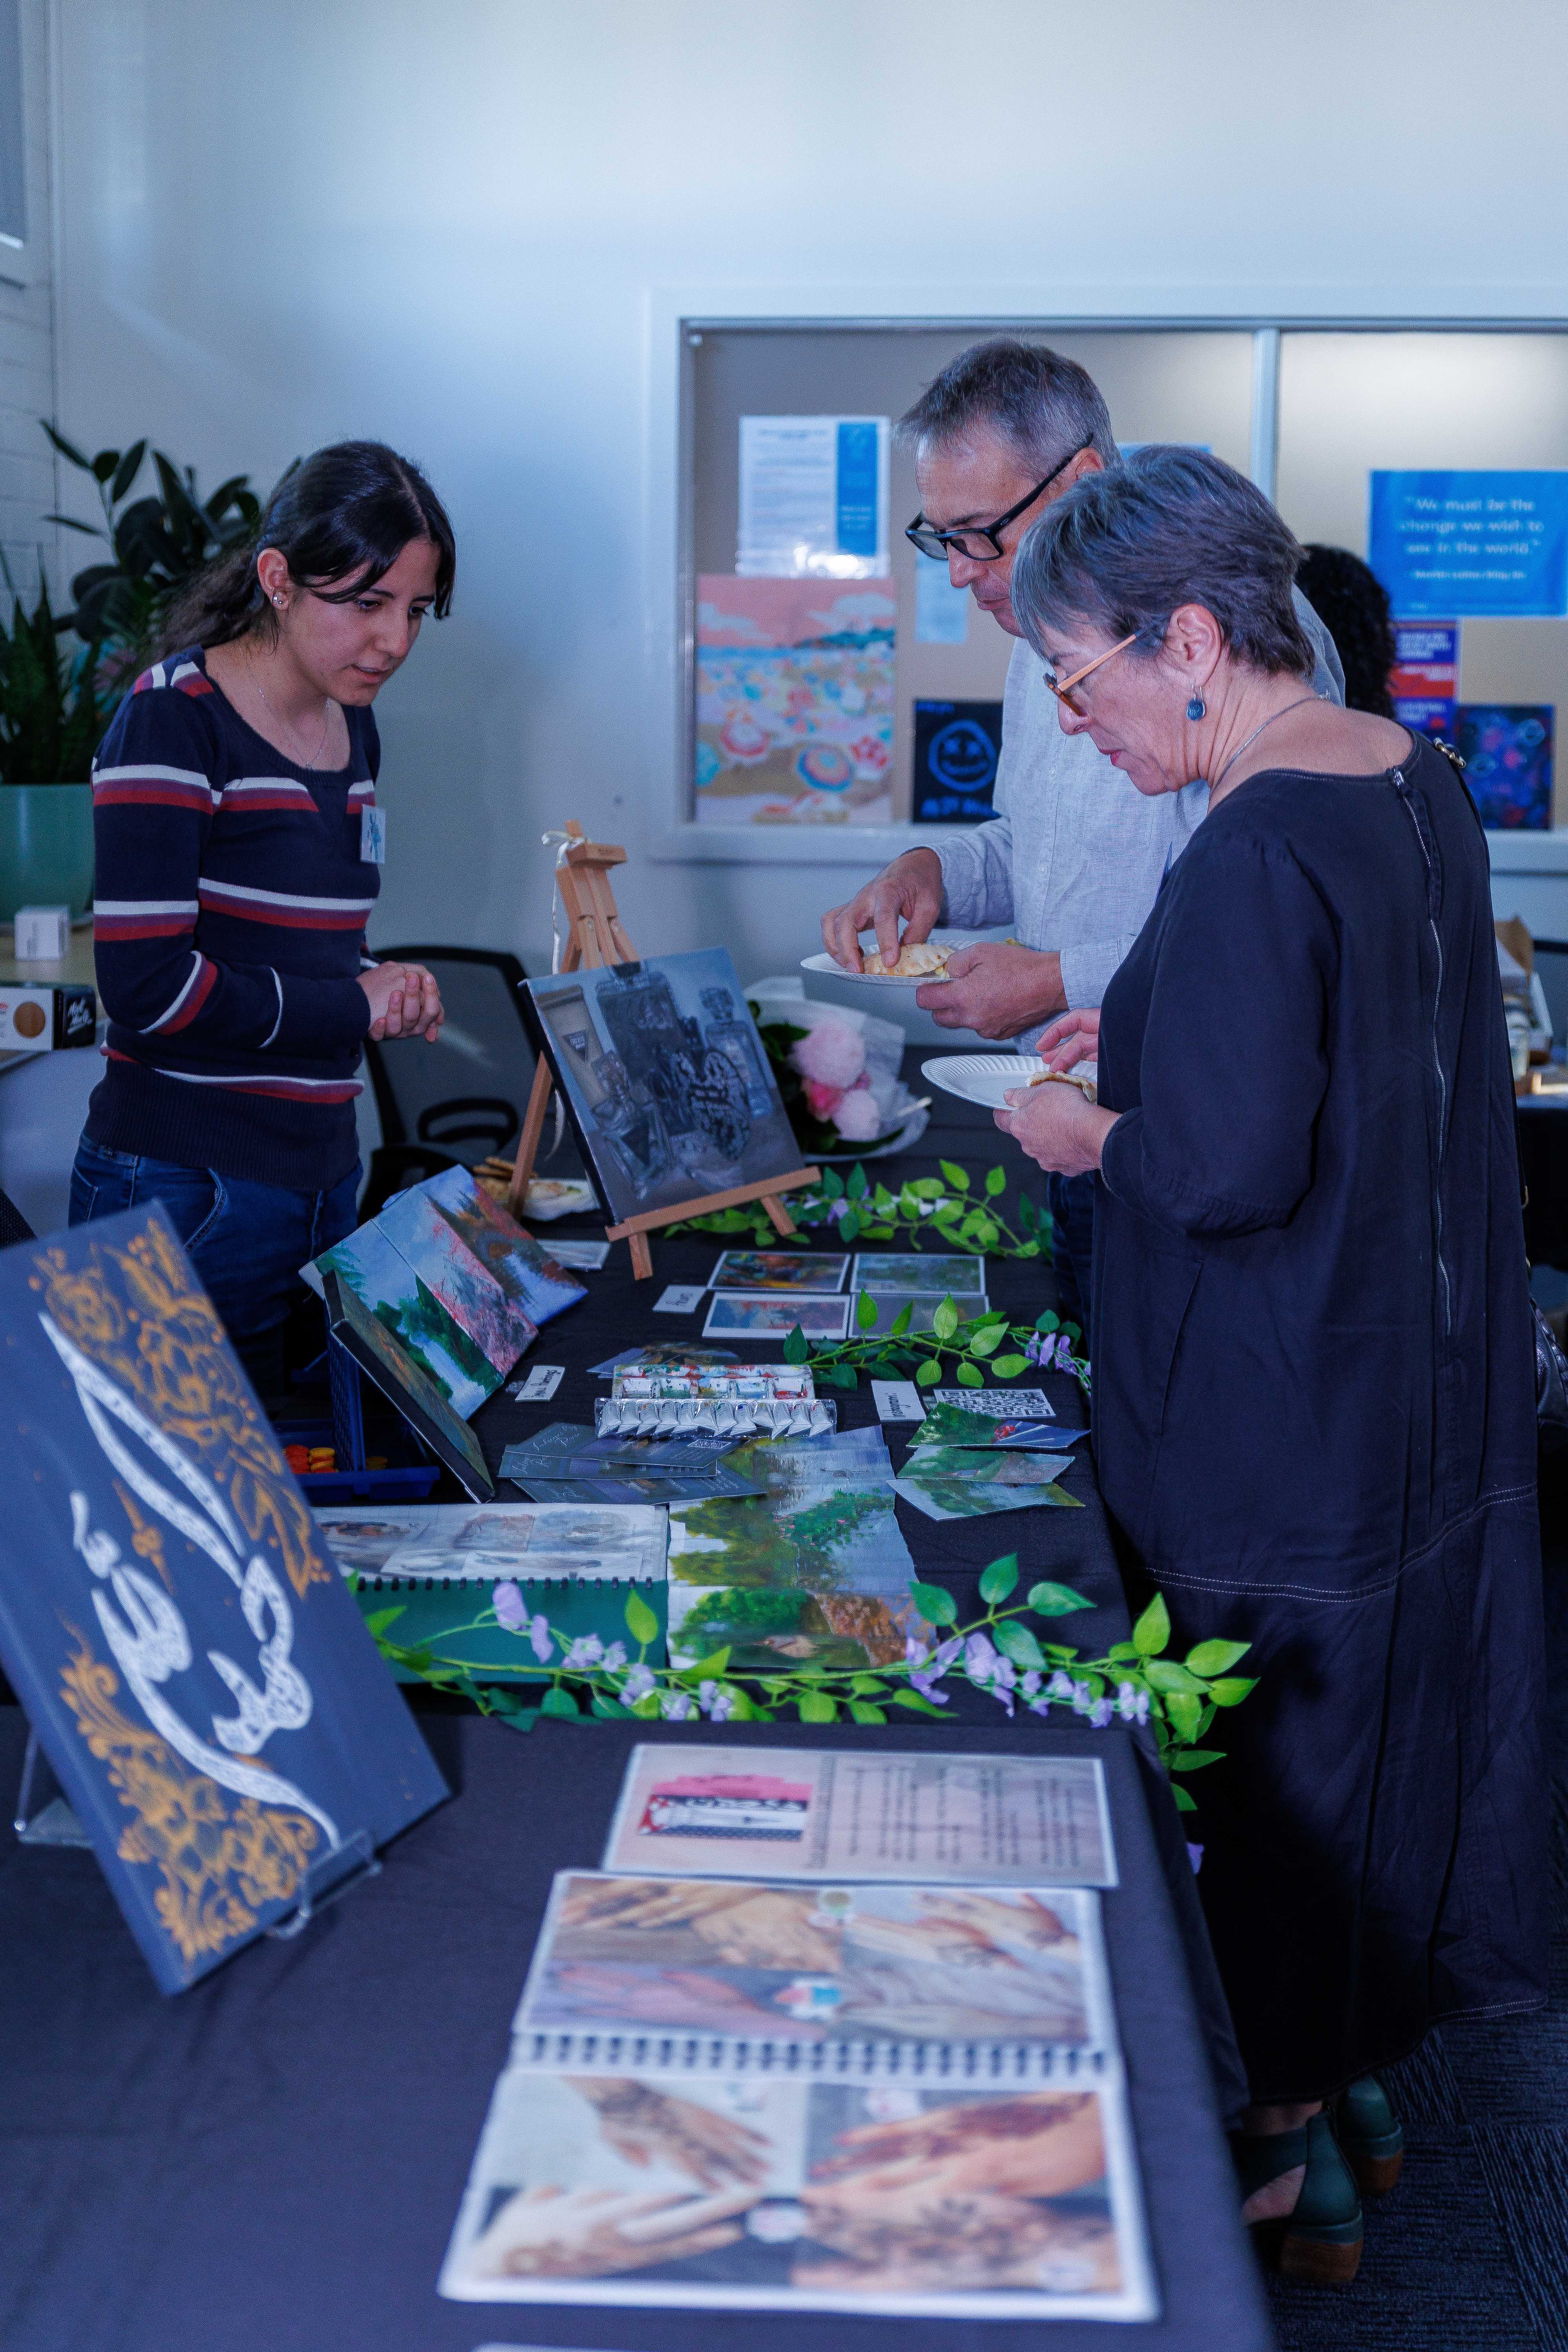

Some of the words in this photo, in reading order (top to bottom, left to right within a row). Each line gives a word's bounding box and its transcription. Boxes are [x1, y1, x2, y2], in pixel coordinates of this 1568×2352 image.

[1445, 499, 1482, 511] must
[1487, 499, 1507, 511] be
[1509, 499, 1534, 511] the
[1400, 521, 1456, 535] change
[1461, 522, 1483, 531] we
[1488, 520, 1522, 532] wish
[1527, 521, 1543, 532] to
[1407, 544, 1430, 553] see
[1437, 543, 1450, 553] in
[1455, 542, 1479, 554] the
